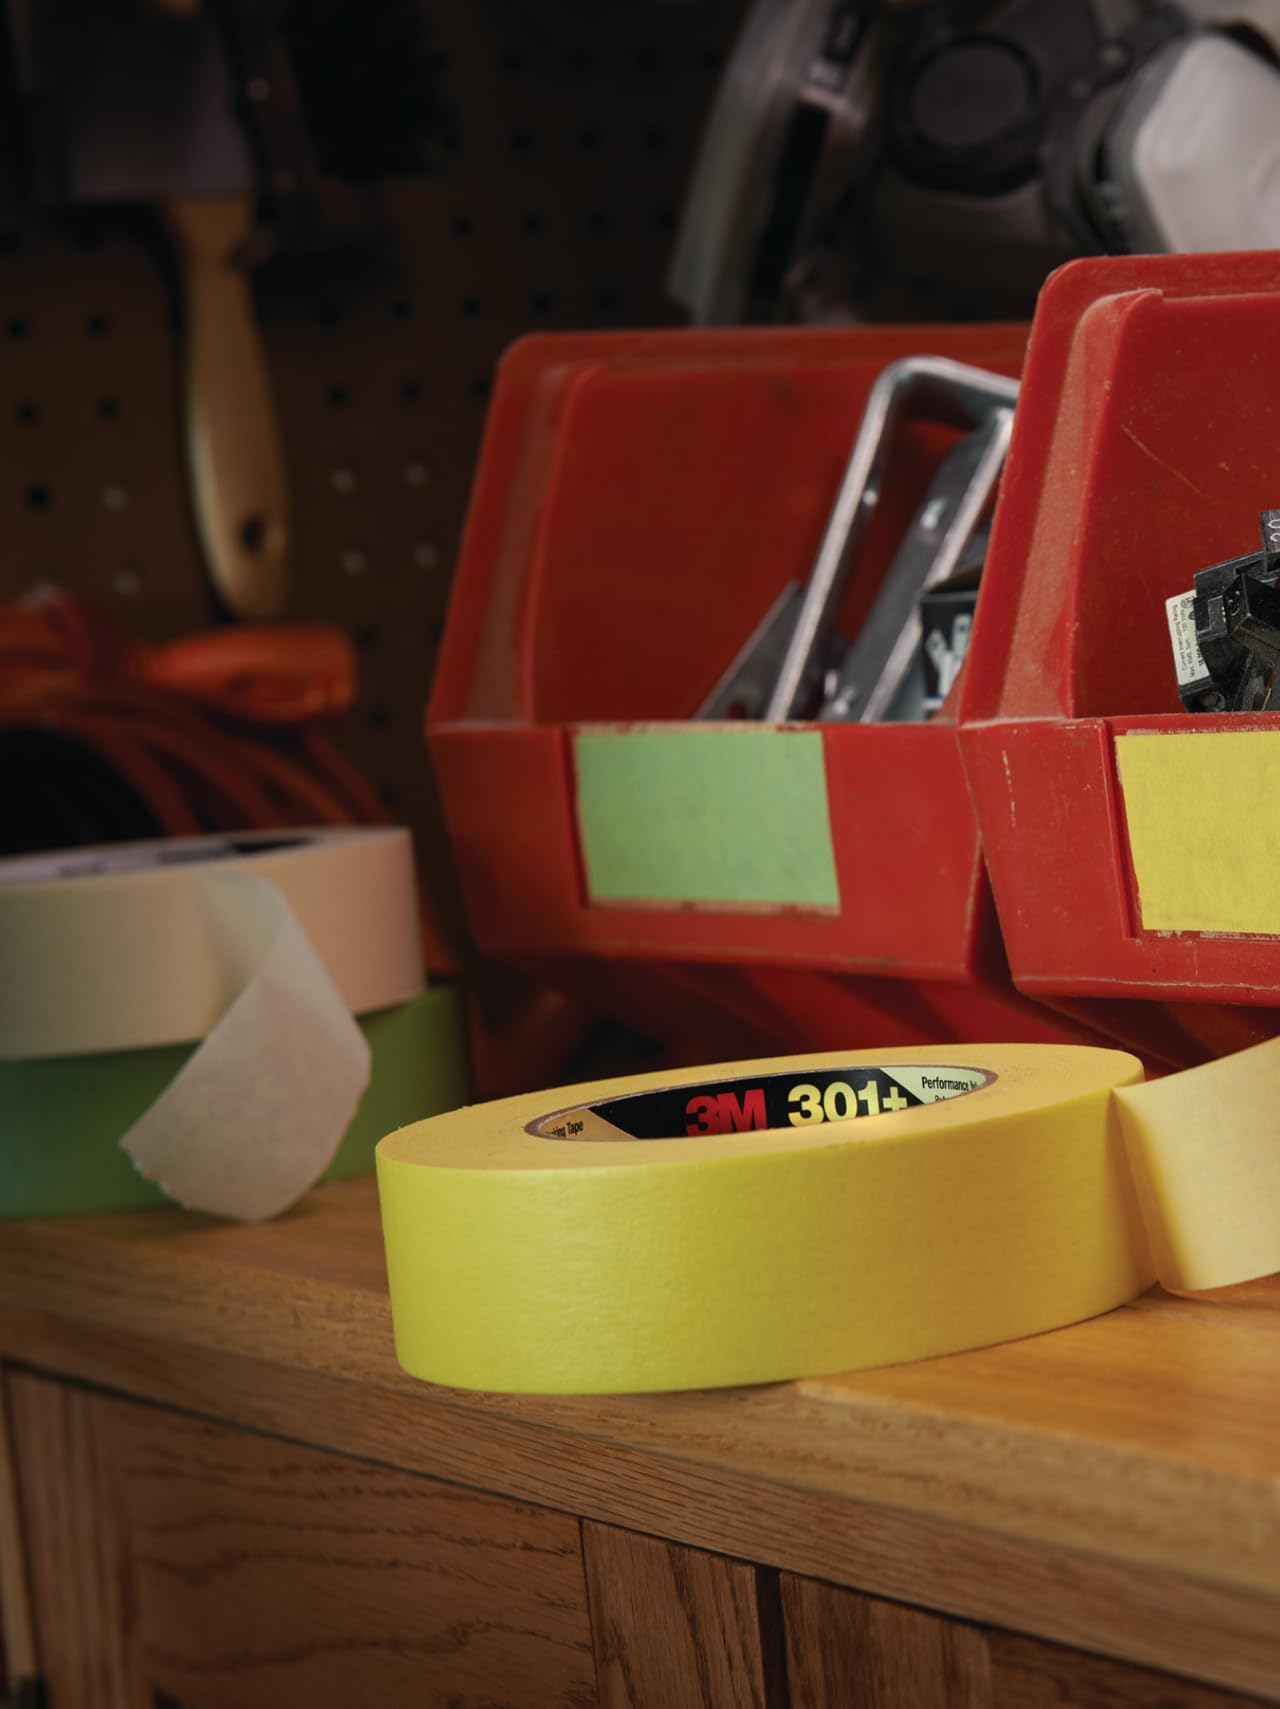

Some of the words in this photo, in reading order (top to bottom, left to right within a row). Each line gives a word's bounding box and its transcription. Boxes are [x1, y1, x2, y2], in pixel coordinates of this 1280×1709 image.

[921, 1076, 969, 1092] Performance
[685, 1088, 769, 1136] 3M
[787, 1080, 907, 1128] 301+
[566, 1121, 584, 1136] Tape
